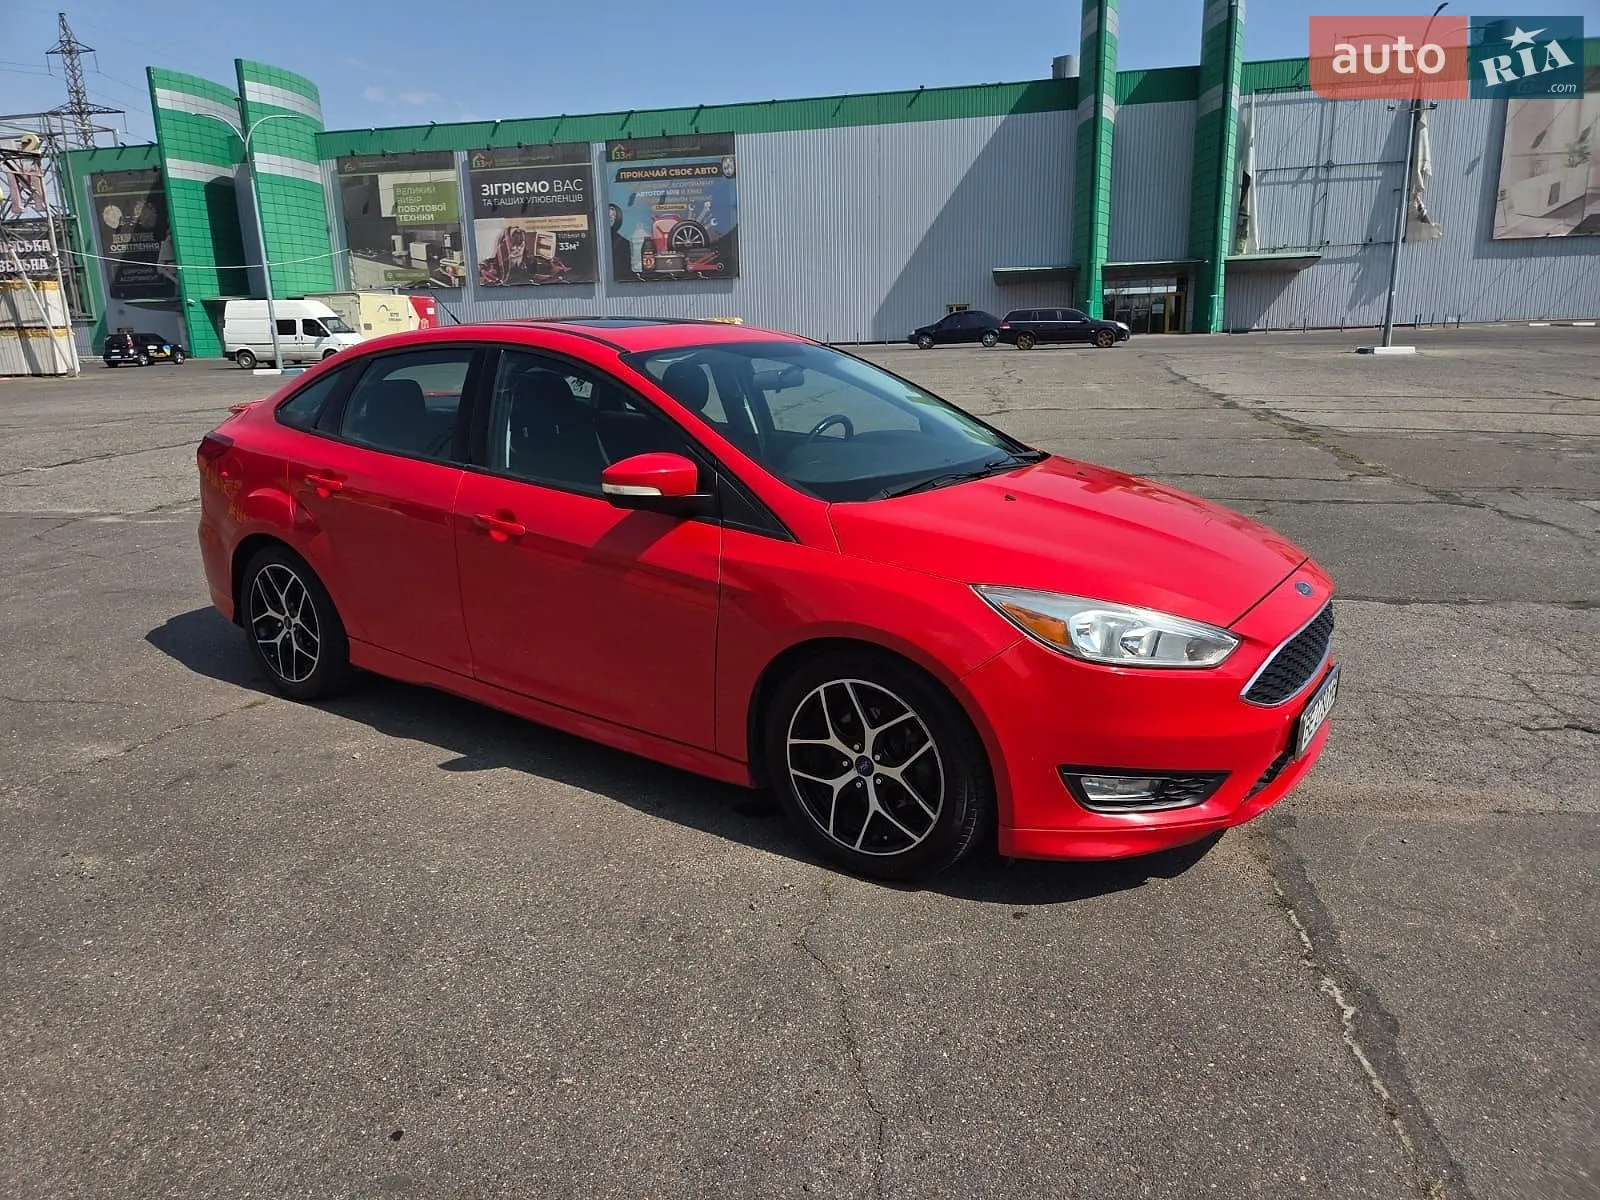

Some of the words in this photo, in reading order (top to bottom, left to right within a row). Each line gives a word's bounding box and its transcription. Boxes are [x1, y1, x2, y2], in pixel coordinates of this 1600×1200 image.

[620, 168, 667, 178] ПРОКАЧАЙ
[669, 168, 693, 176] СВОЄ
[694, 166, 718, 175] АВТО
[481, 180, 550, 196] ЗІГРІЄМО
[553, 179, 583, 192] ВАС
[482, 198, 493, 207] ТА
[494, 197, 525, 206] ВАШИХ
[527, 193, 584, 205] УЛЮБЛЕНЦІВ
[397, 202, 447, 213] ПОБУТОВОЇ
[399, 213, 434, 222] ТЕХНІКИ
